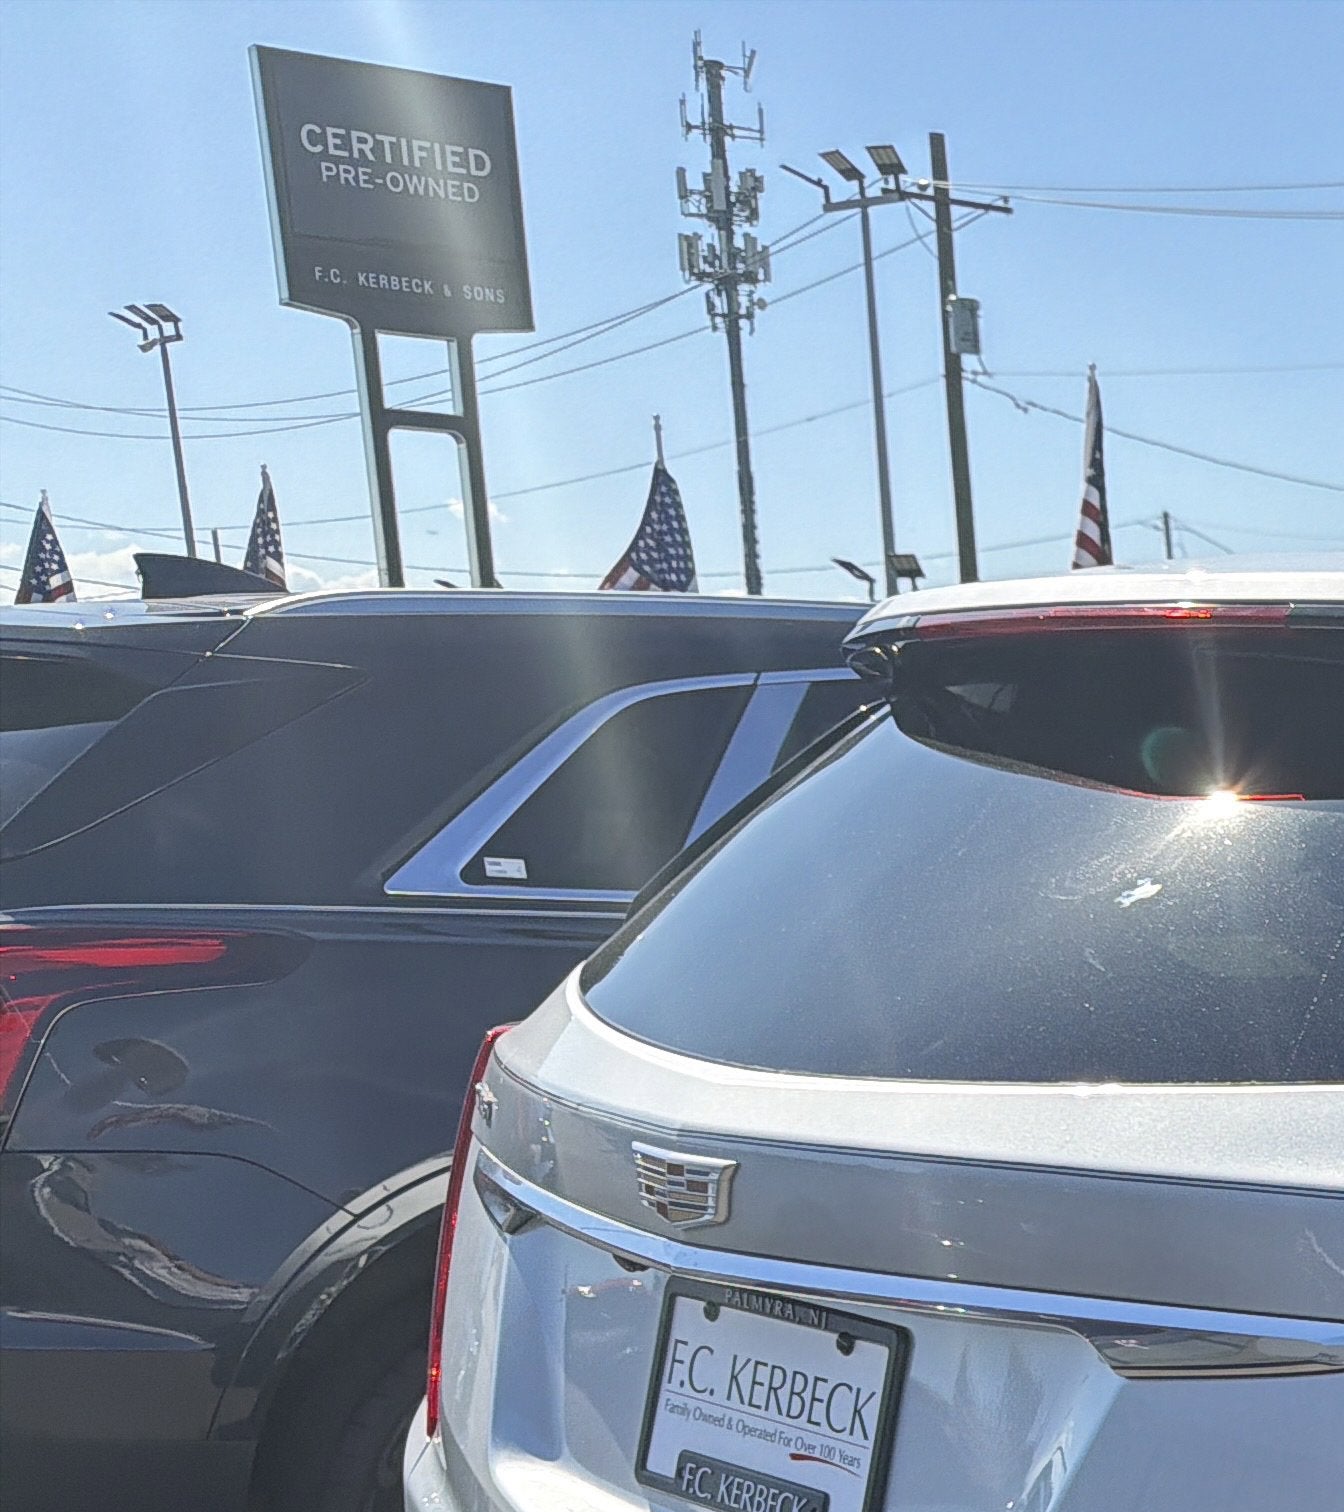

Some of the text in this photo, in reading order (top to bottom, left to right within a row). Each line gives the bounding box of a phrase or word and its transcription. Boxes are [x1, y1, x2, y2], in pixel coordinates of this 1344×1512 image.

[300, 123, 492, 176] CERTIFIED
[320, 161, 480, 203] PRE-OWNED
[314, 267, 347, 284] F.C.
[357, 272, 434, 295] KERBECK
[462, 284, 505, 303] SONS
[809, 1308, 827, 1330] NJ
[667, 1338, 877, 1441] F.C. KERBECK
[664, 1398, 861, 1469] Family Owned & Operated For Over 100 Years
